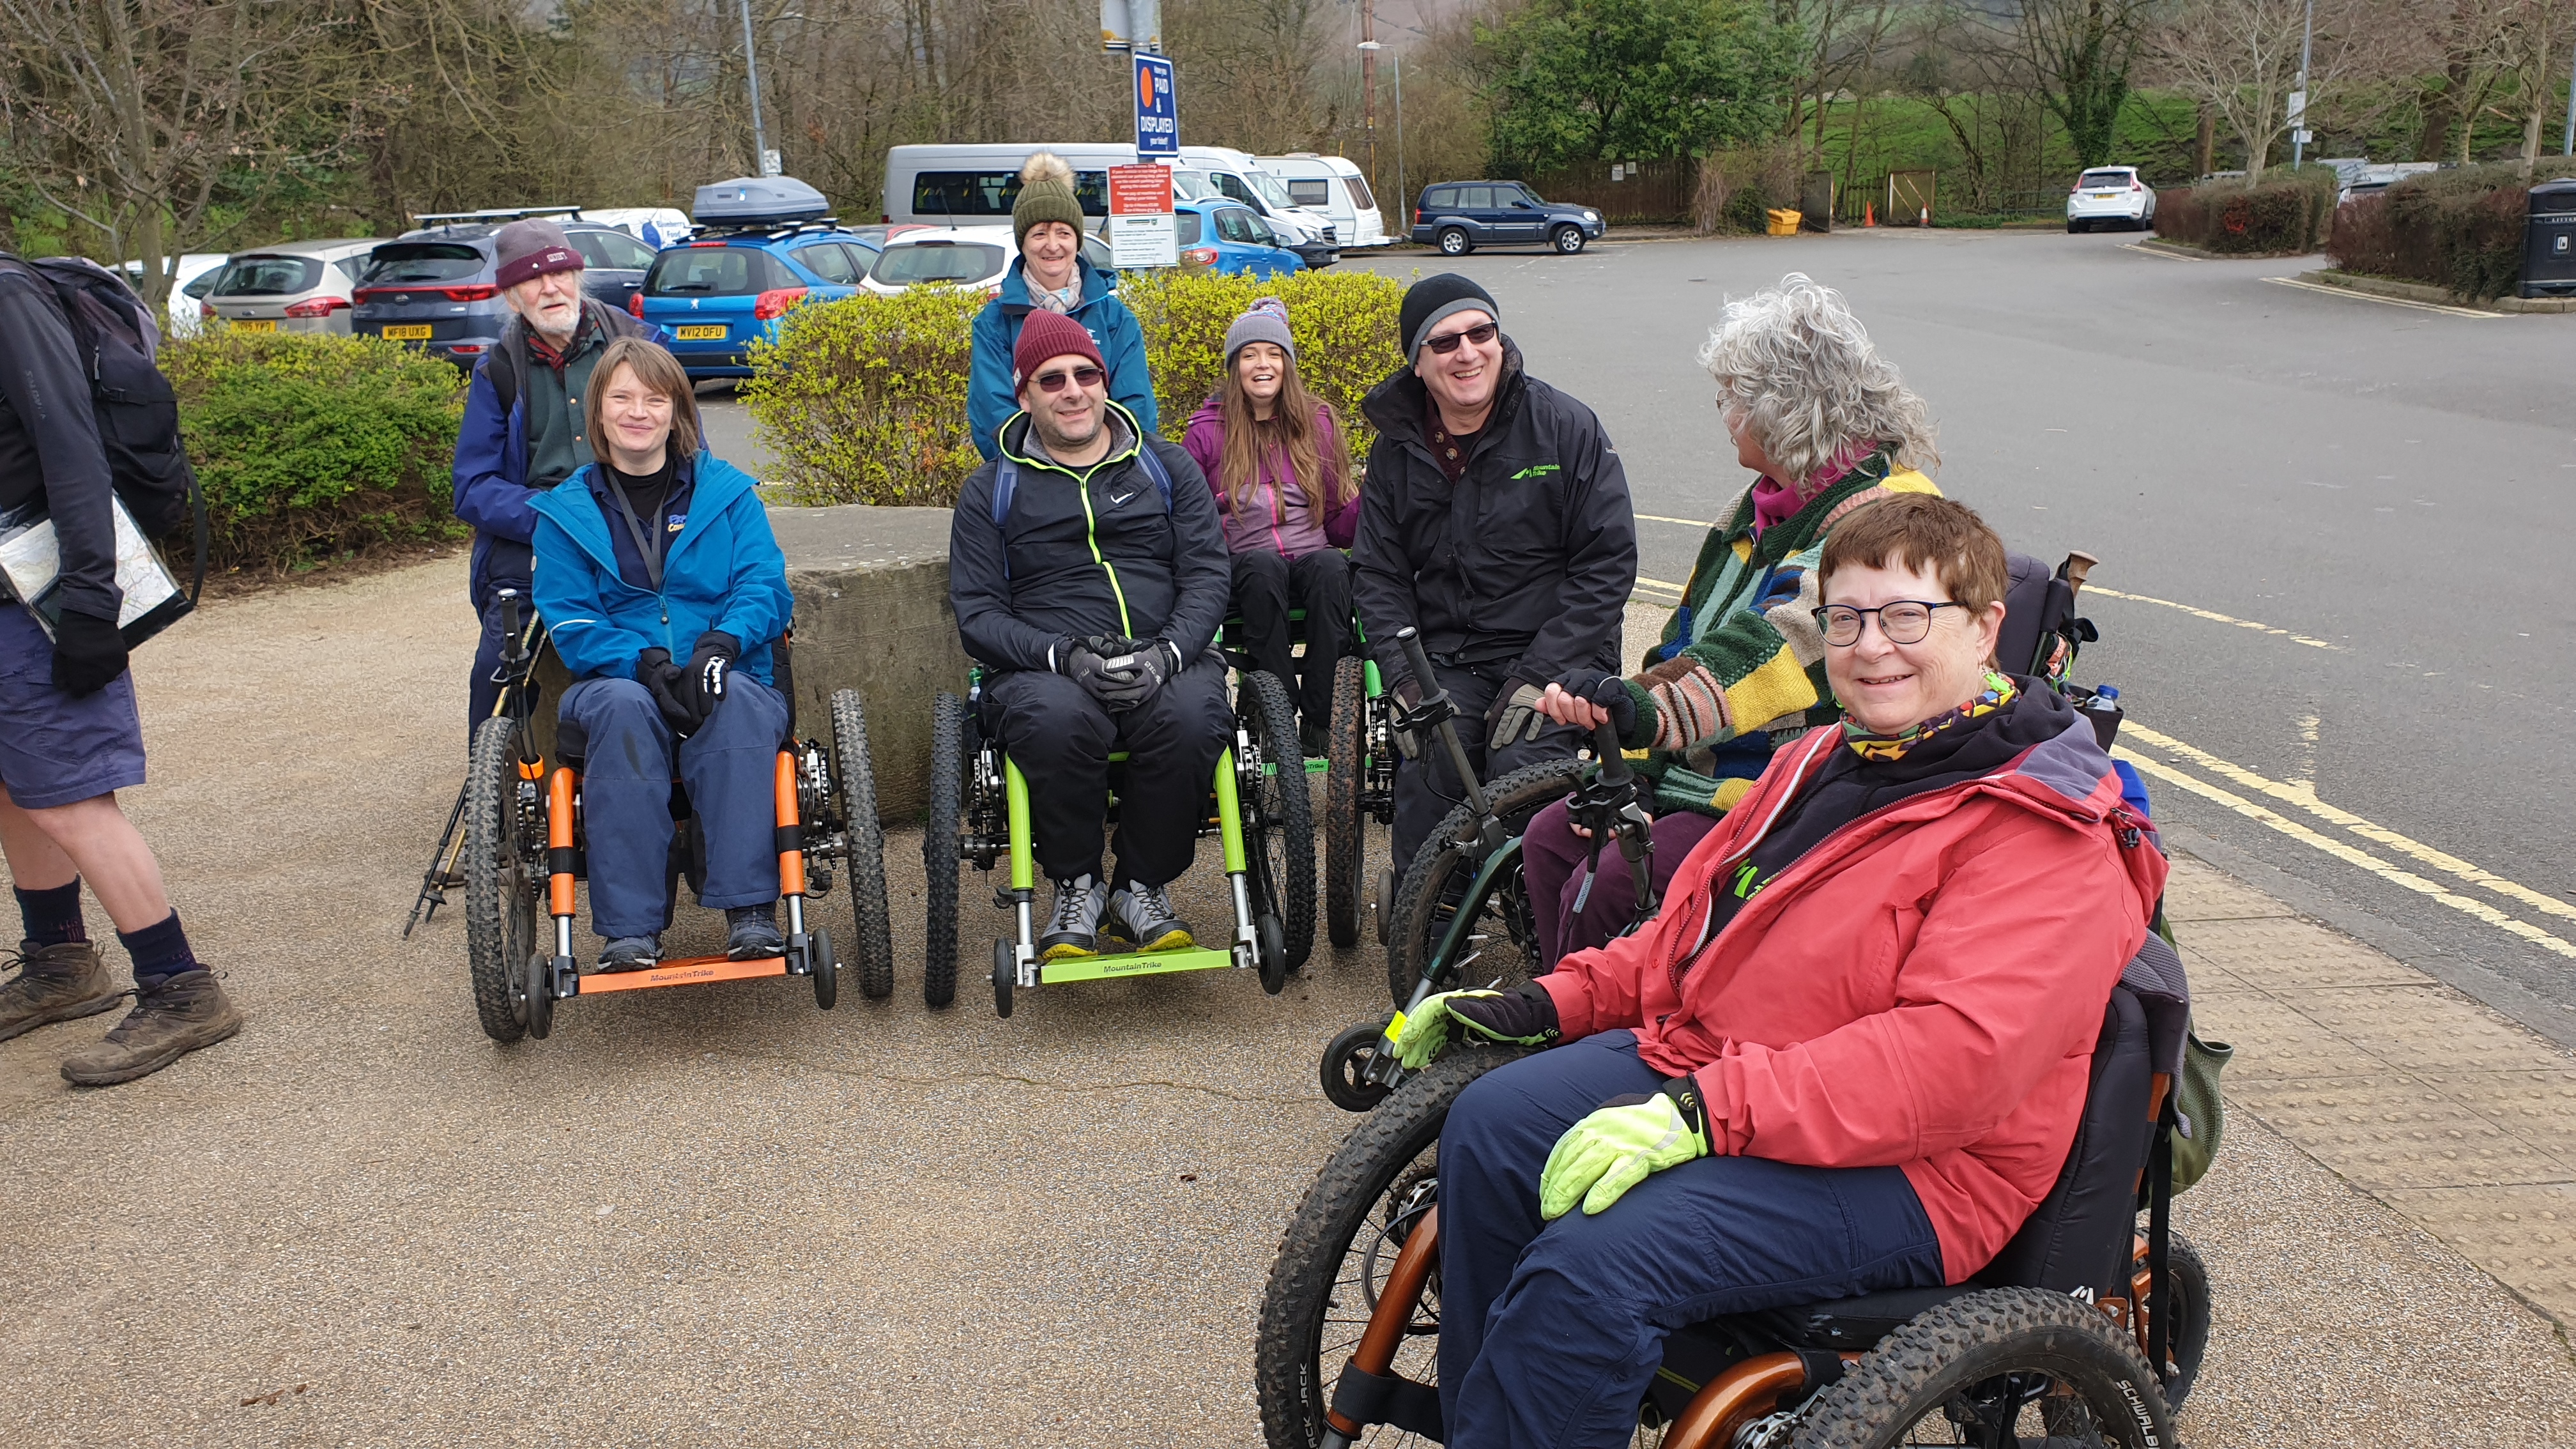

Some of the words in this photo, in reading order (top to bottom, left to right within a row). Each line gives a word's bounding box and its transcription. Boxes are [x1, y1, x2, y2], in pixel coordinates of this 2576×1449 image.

[1154, 77, 1169, 94] PAID
[1156, 97, 1162, 113] &
[1140, 116, 1174, 134] DISPLAYED
[409, 326, 426, 337] UXG
[680, 327, 701, 337] MV12
[703, 327, 722, 337] OFU
[1300, 1362, 1309, 1407] JACK
[2115, 1379, 2160, 1449] SCHWALB
[1303, 1415, 1318, 1449] ACK
